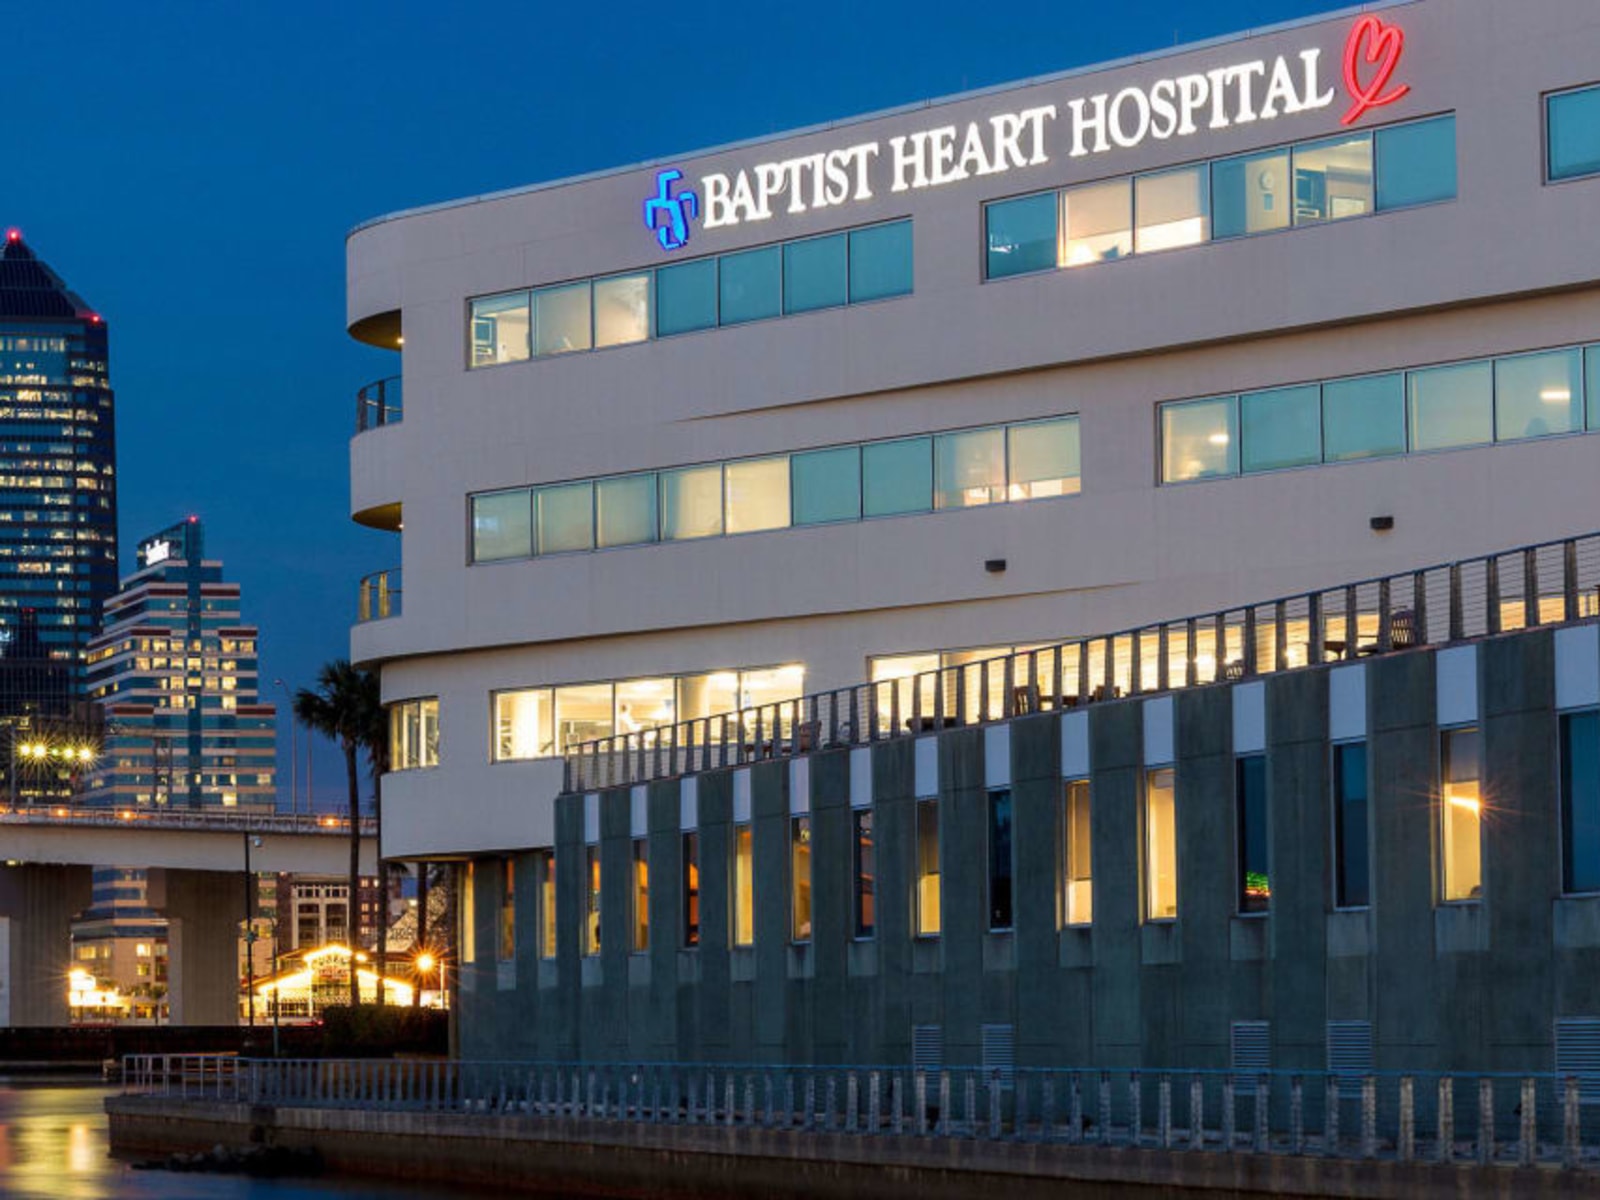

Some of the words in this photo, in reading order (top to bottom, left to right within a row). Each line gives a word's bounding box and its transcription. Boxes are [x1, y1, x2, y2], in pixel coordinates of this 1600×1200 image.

[701, 142, 879, 228] BAPTIST
[889, 105, 1056, 193] HEART
[1068, 48, 1335, 157] HOSPITAL
